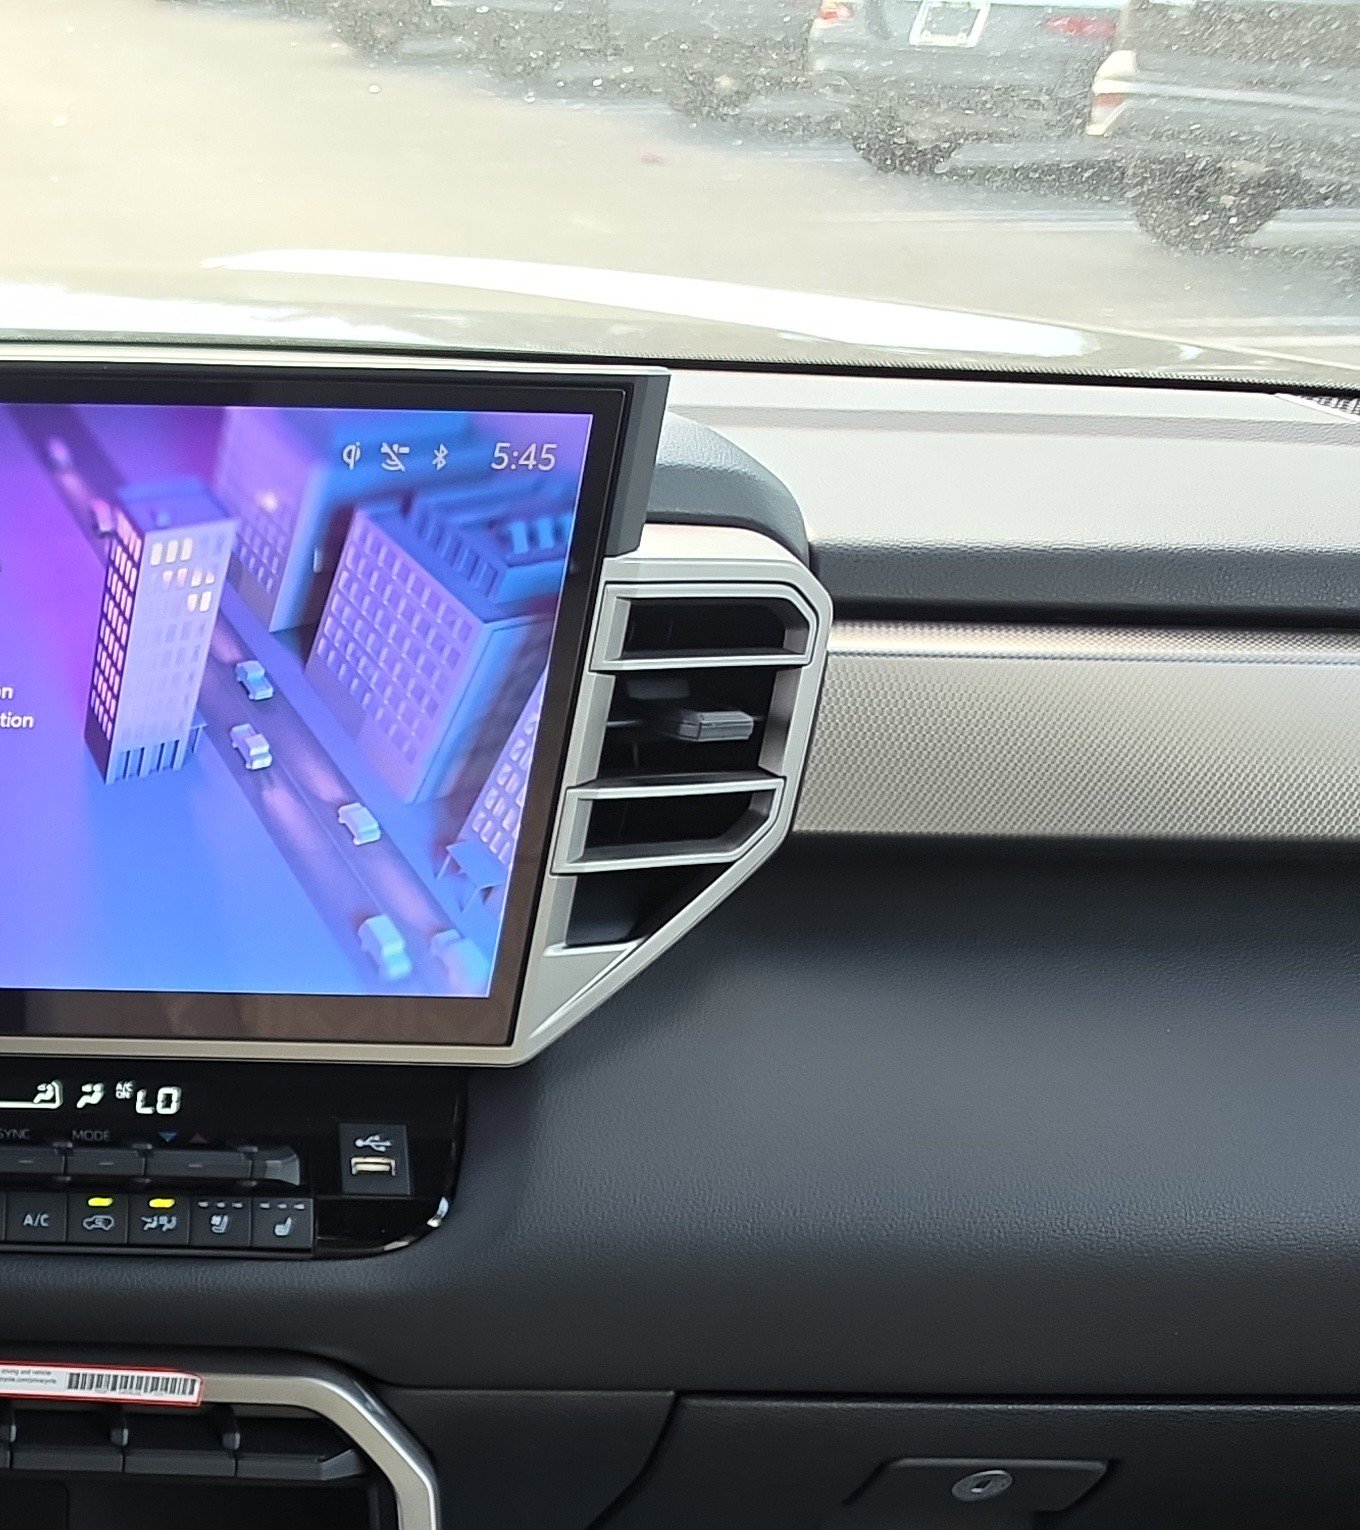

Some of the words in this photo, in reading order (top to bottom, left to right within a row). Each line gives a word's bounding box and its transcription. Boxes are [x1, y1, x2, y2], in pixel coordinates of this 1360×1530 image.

[490, 442, 558, 472] 5:45
[71, 1130, 111, 1142] MODE
[22, 1213, 50, 1227] A/C
